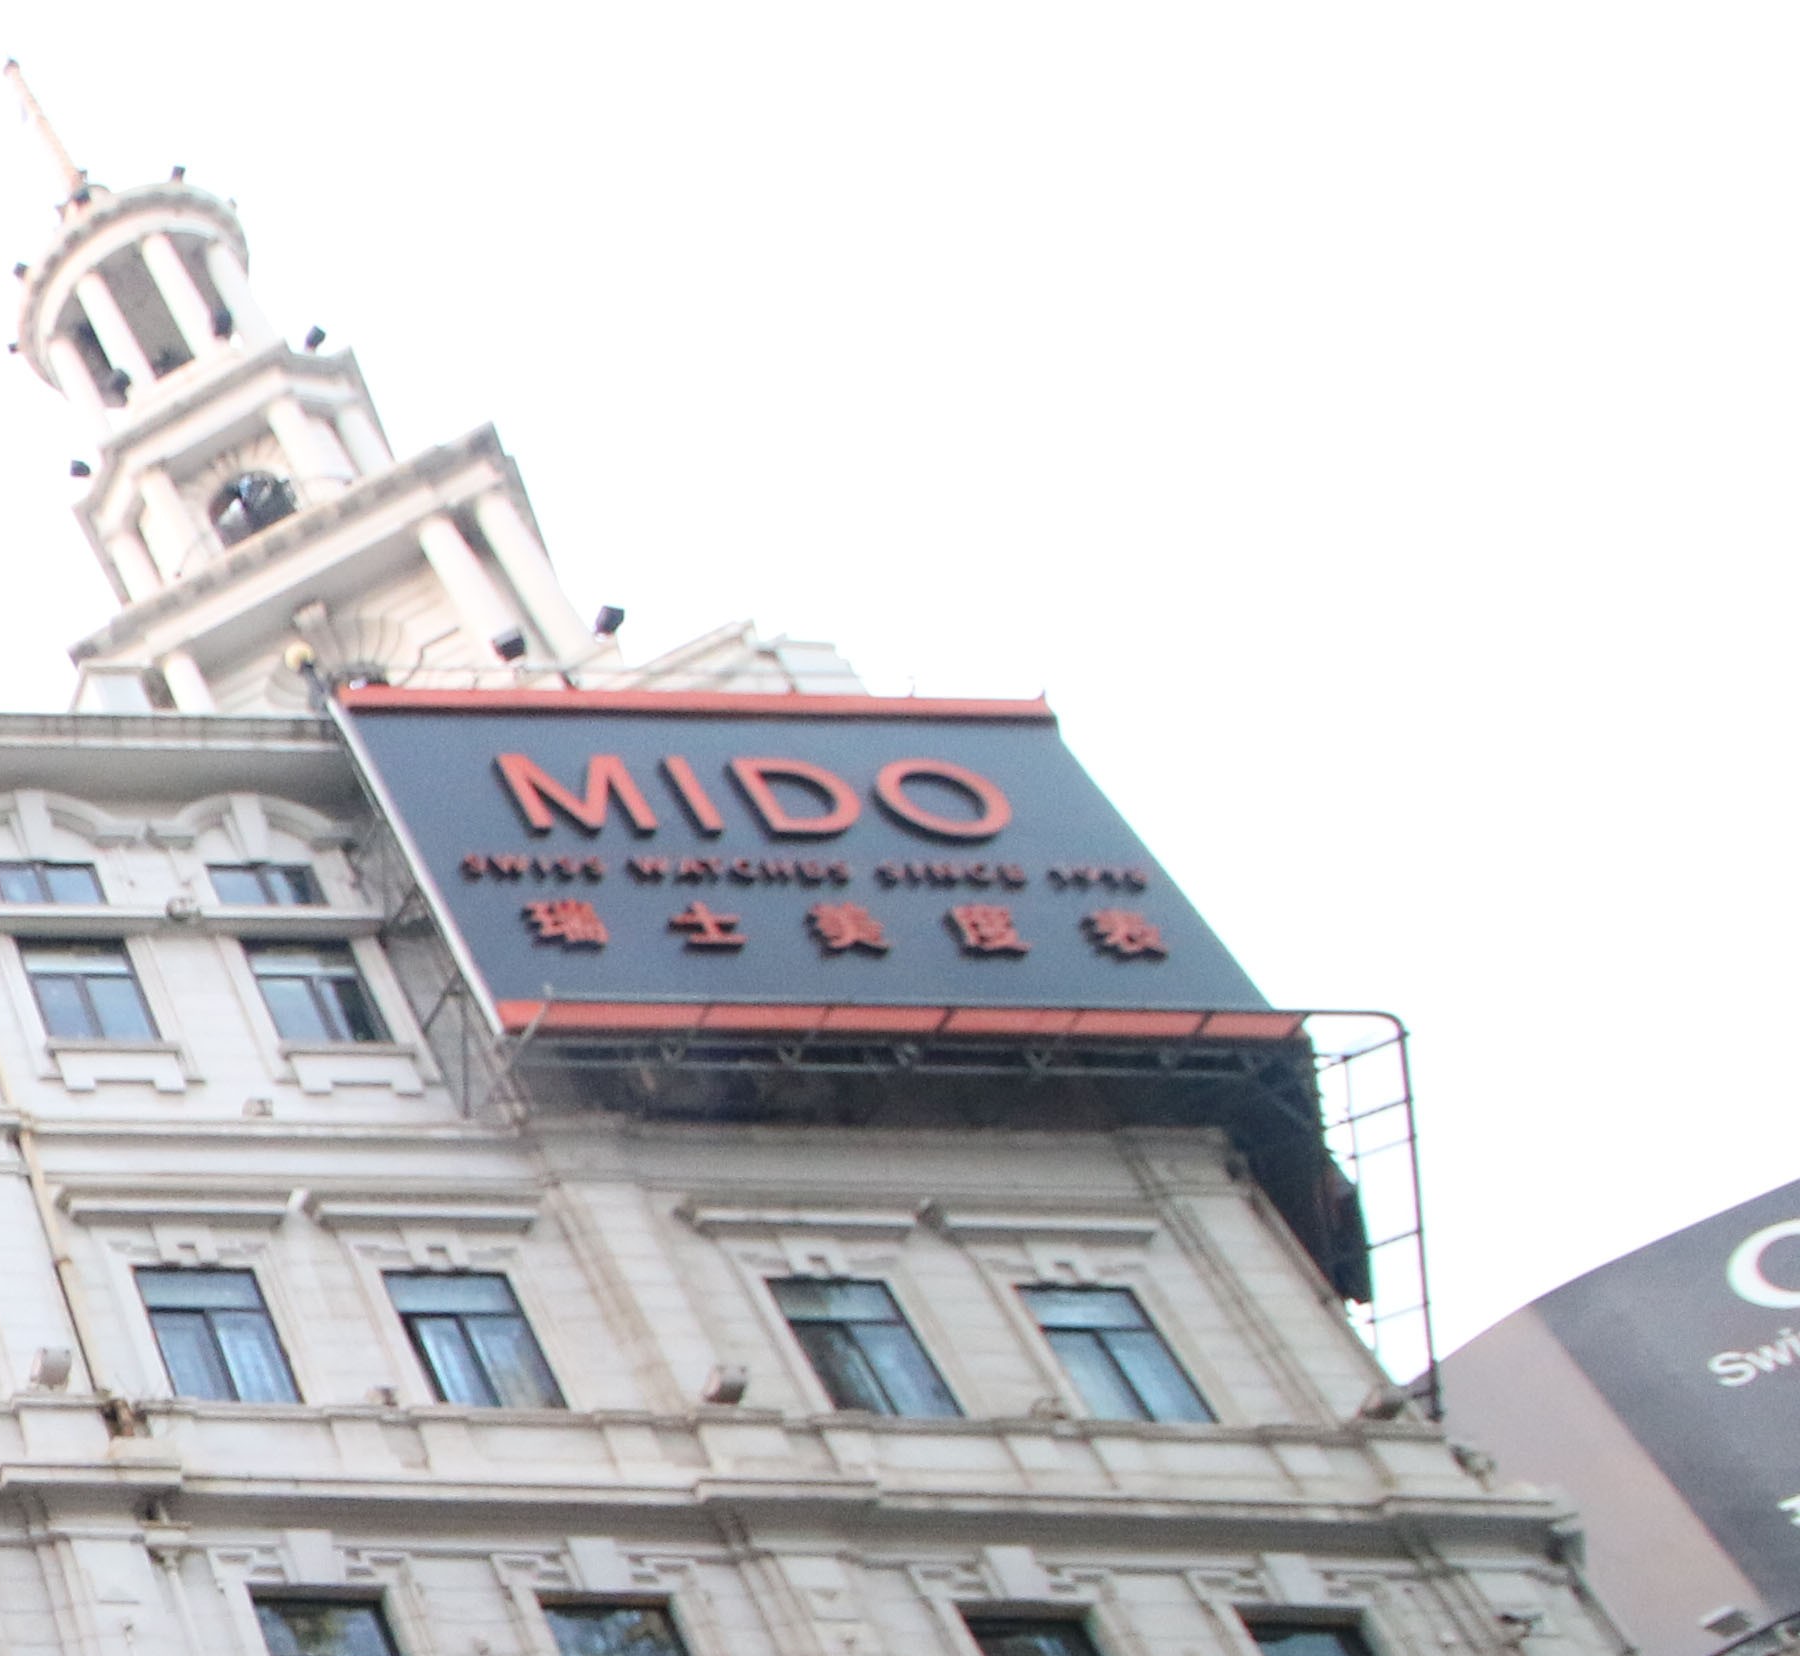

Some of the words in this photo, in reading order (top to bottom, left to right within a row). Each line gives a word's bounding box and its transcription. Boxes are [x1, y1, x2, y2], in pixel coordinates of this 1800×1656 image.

[493, 752, 1013, 840] MIDO
[461, 852, 605, 884] SWISS
[626, 855, 850, 887] WATCHES
[521, 899, 1169, 960] 瑞士美度表
